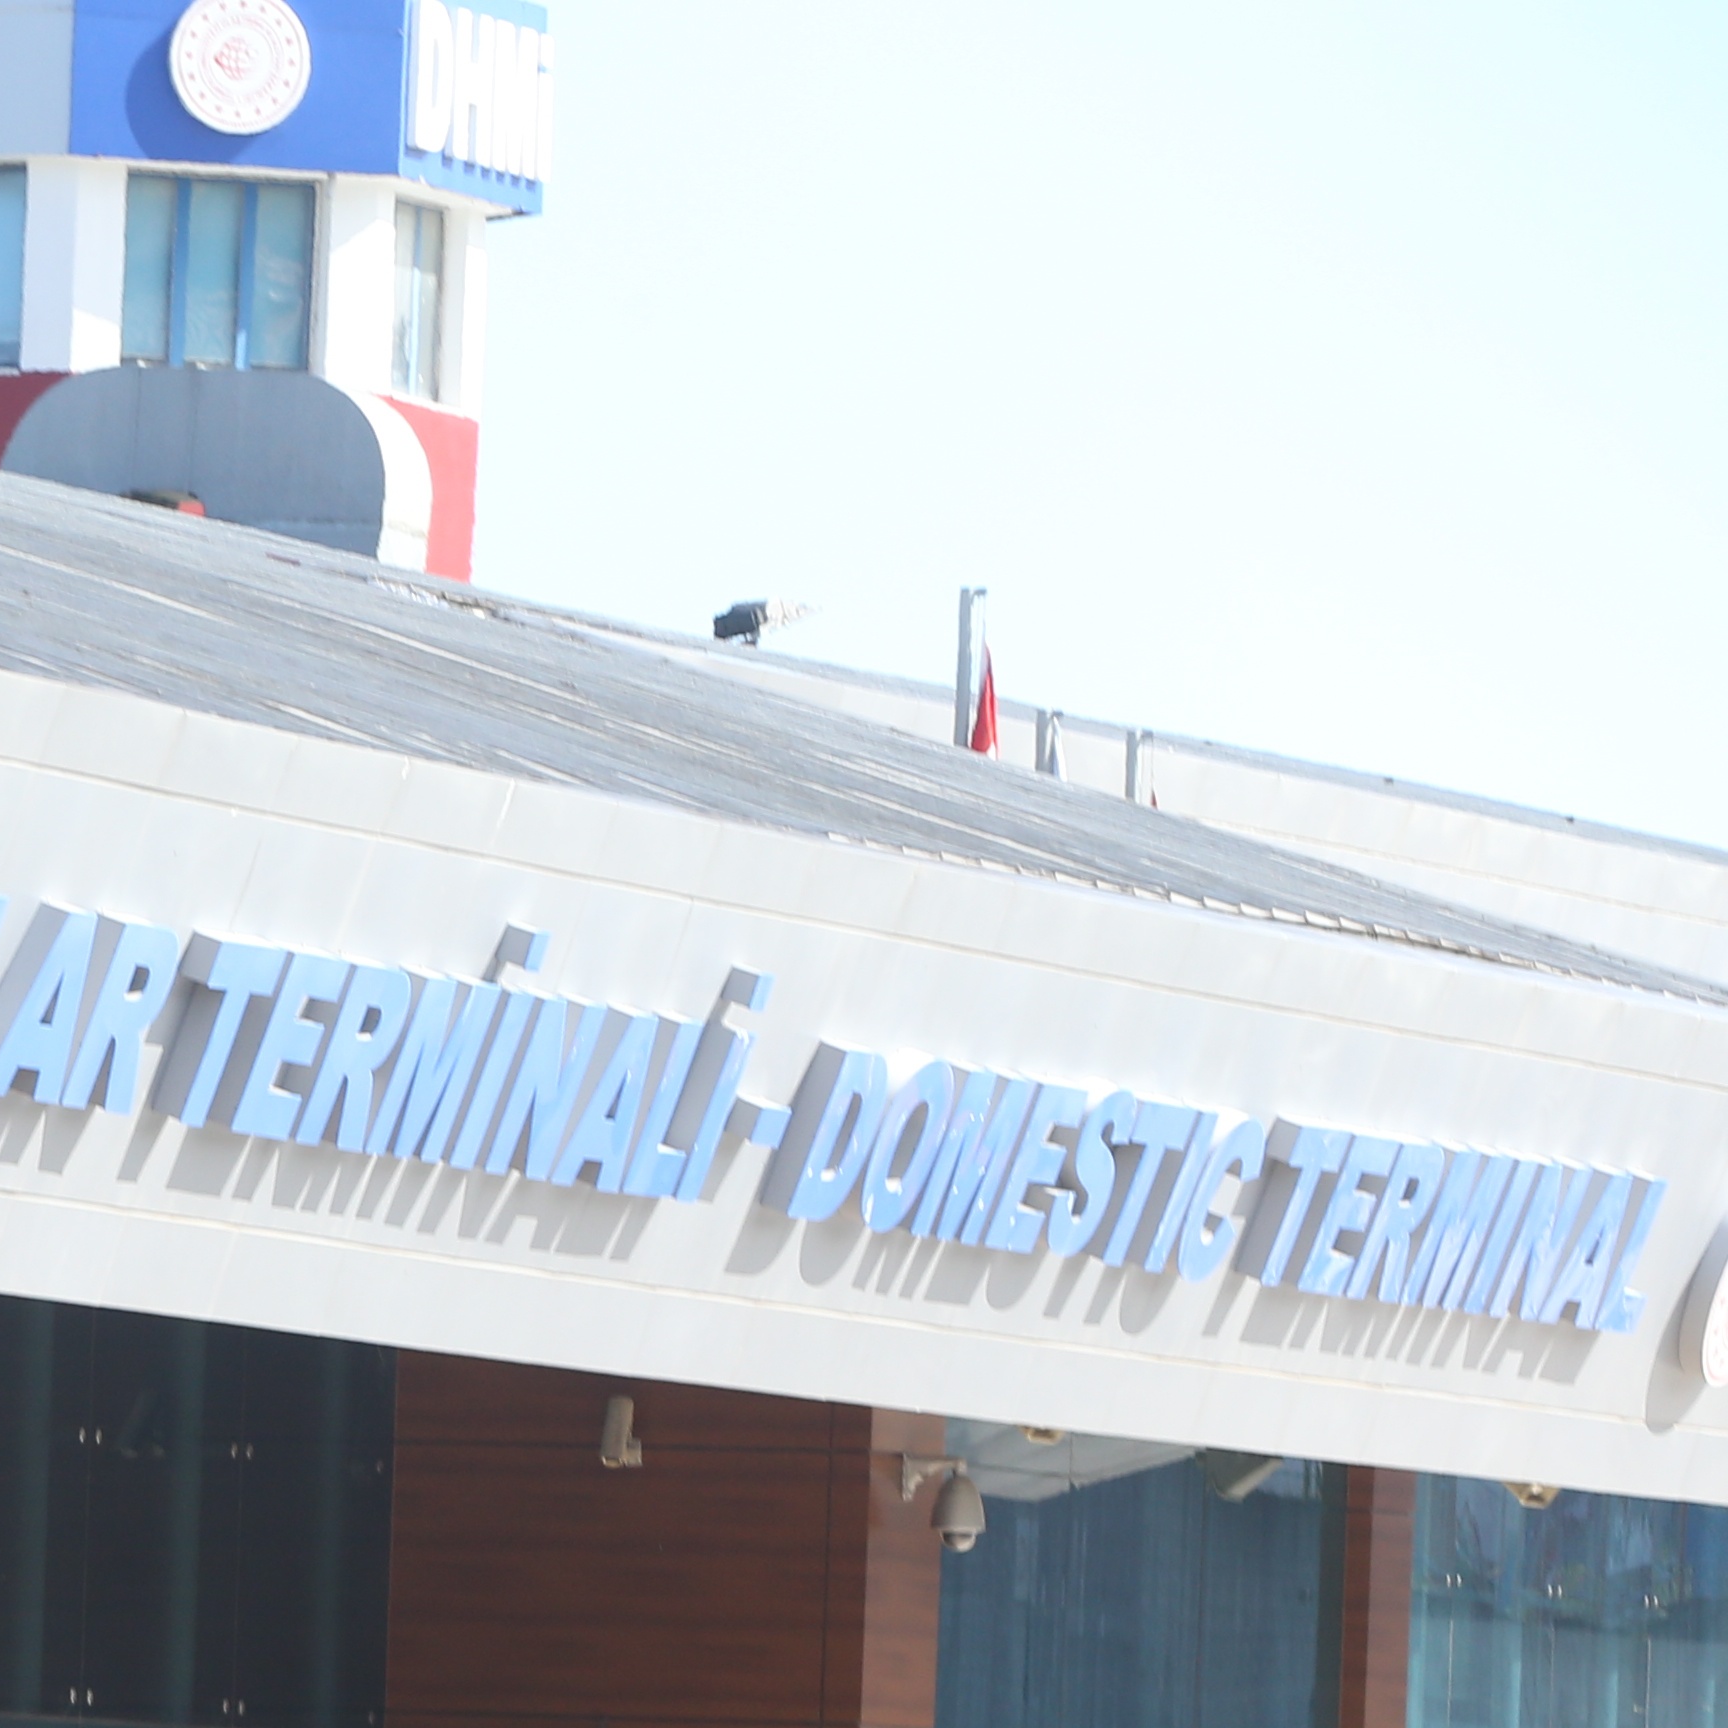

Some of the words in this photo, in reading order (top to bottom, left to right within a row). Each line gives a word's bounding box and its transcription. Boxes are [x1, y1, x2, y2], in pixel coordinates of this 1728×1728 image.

[174, 922, 774, 1202] TERMİNALİ
[784, 1043, 1264, 1284] DOMESTIC
[1260, 1116, 1669, 1334] TERMINAL
